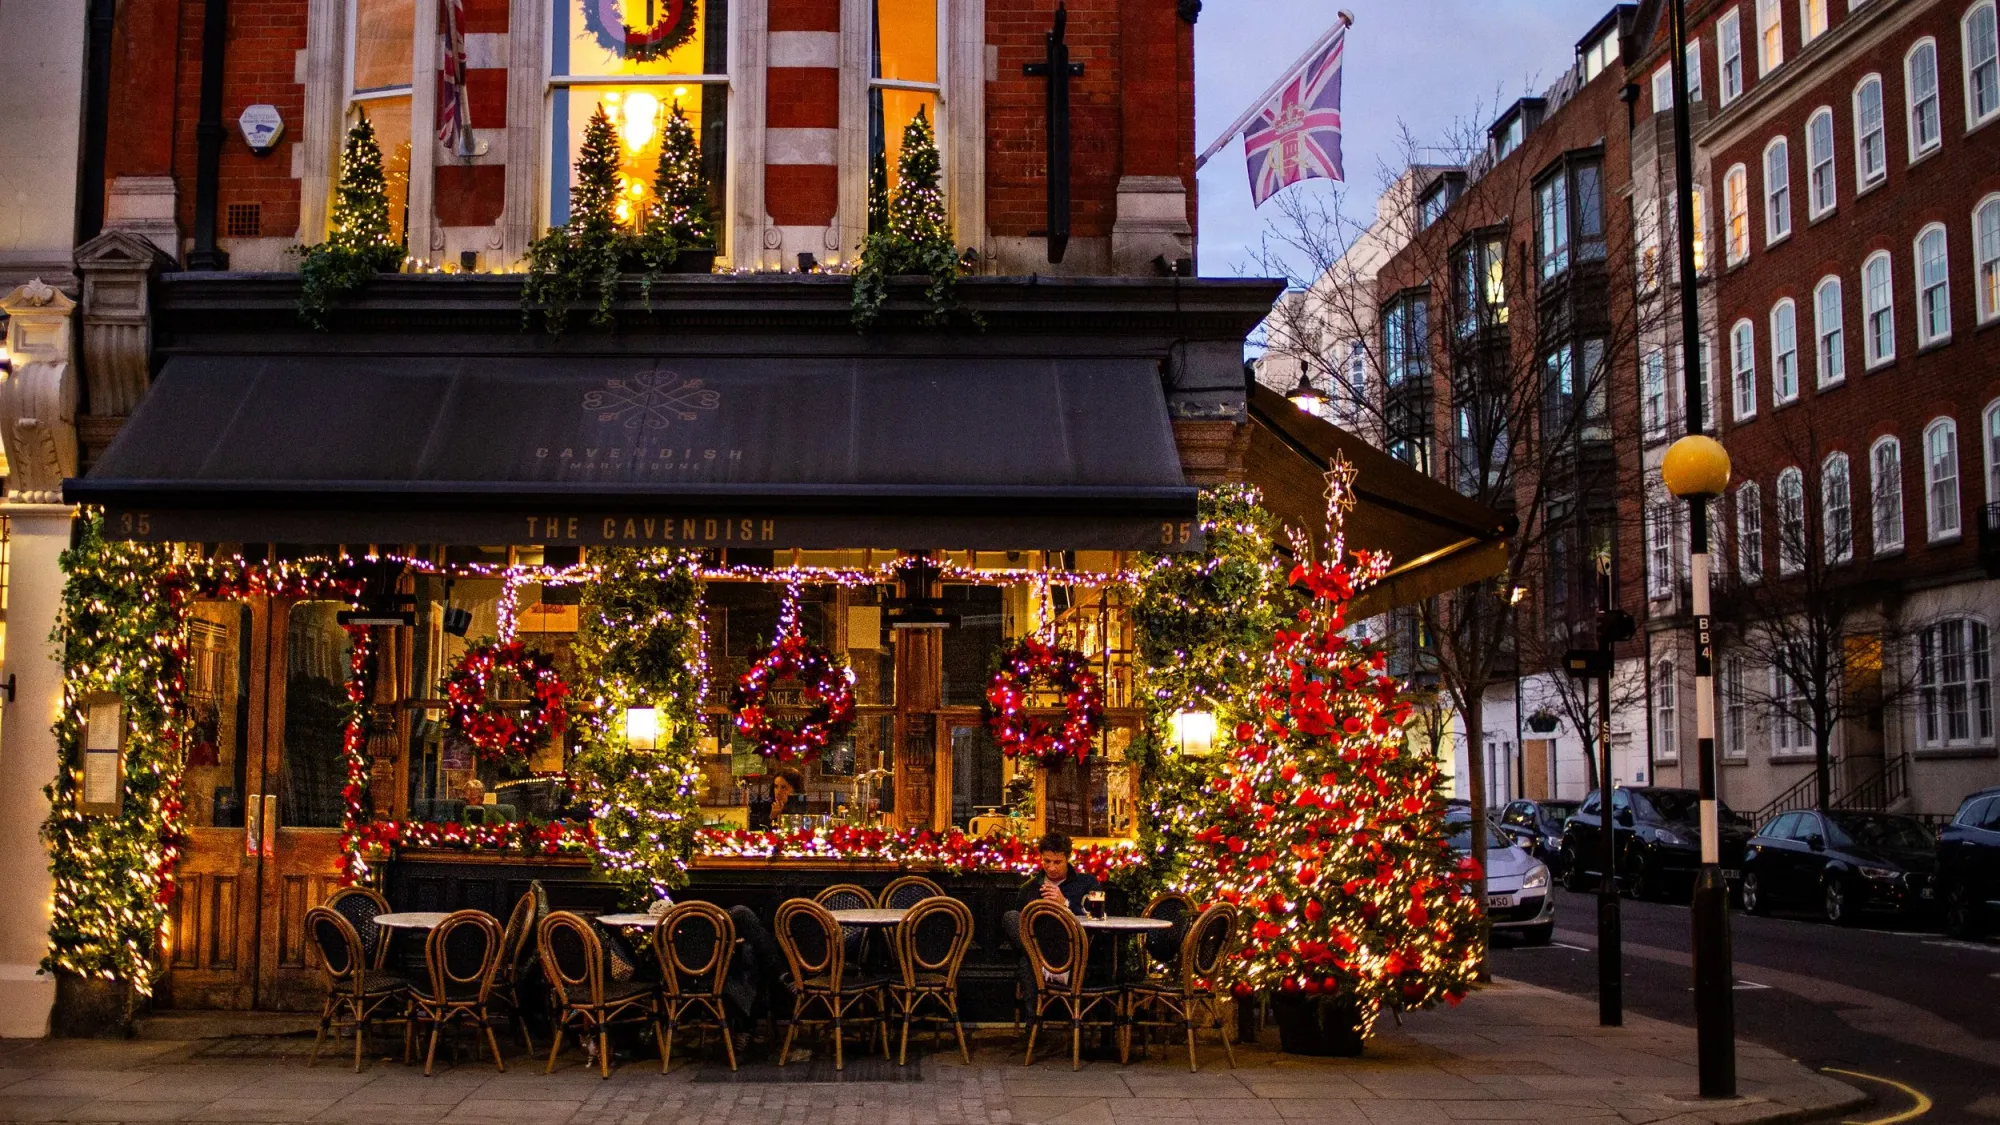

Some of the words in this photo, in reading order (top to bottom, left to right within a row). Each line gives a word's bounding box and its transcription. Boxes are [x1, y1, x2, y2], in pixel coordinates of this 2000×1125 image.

[535, 447, 743, 461] CAVENDISH
[527, 517, 578, 539] THE
[602, 517, 775, 541] CAVENDISH
[1161, 522, 1191, 545] 35
